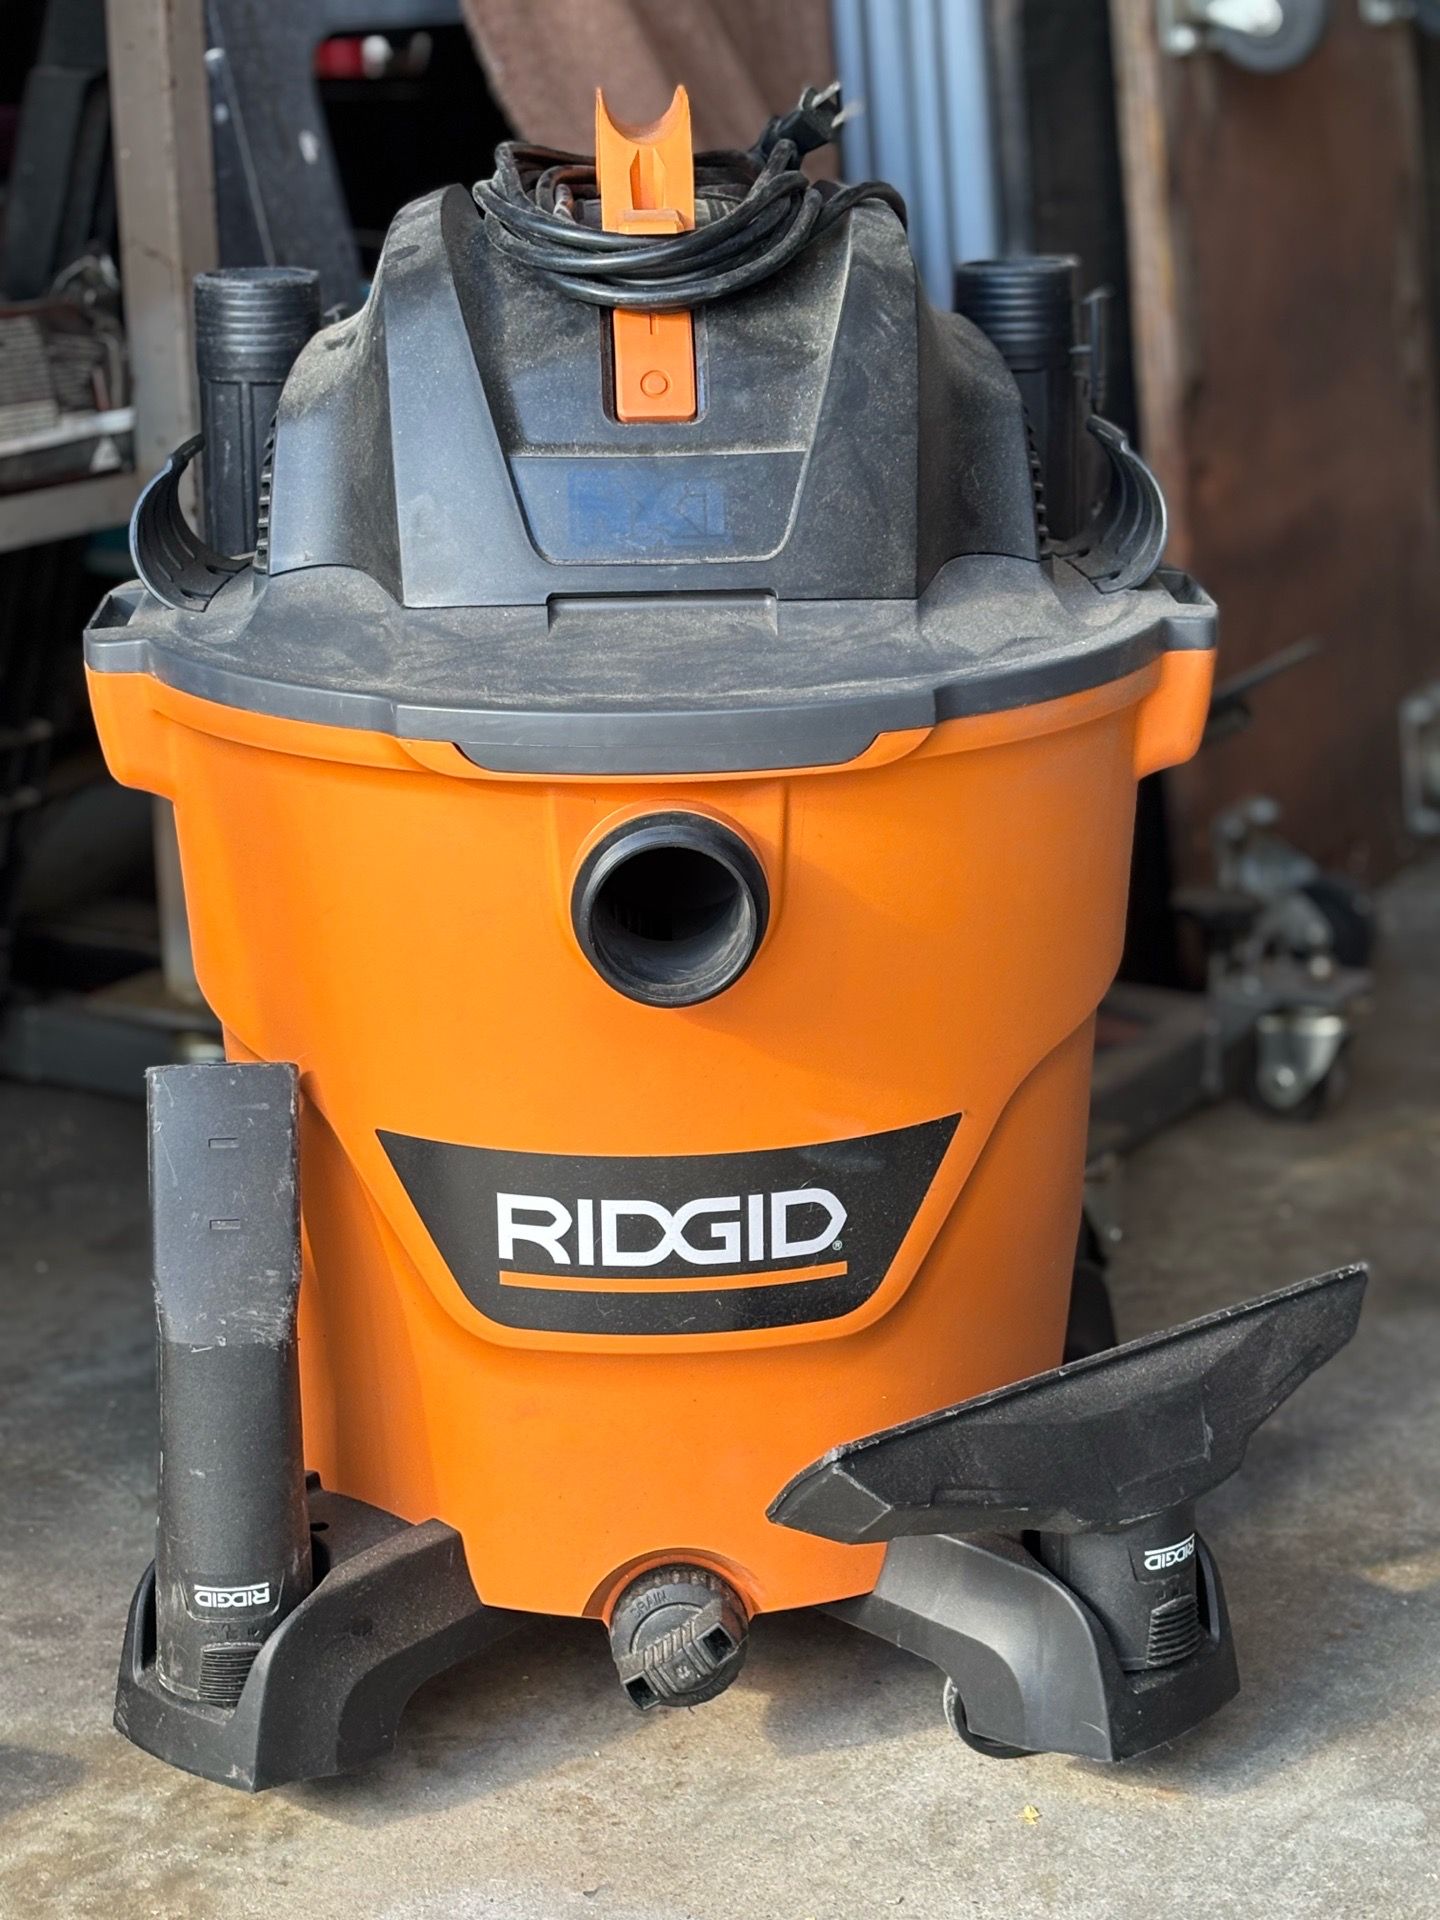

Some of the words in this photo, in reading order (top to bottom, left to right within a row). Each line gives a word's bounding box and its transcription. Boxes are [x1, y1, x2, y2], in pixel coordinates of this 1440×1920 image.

[497, 1188, 847, 1266] RIDGID
[1143, 1538, 1195, 1570] RIDGID
[193, 1587, 270, 1608] RIDGID
